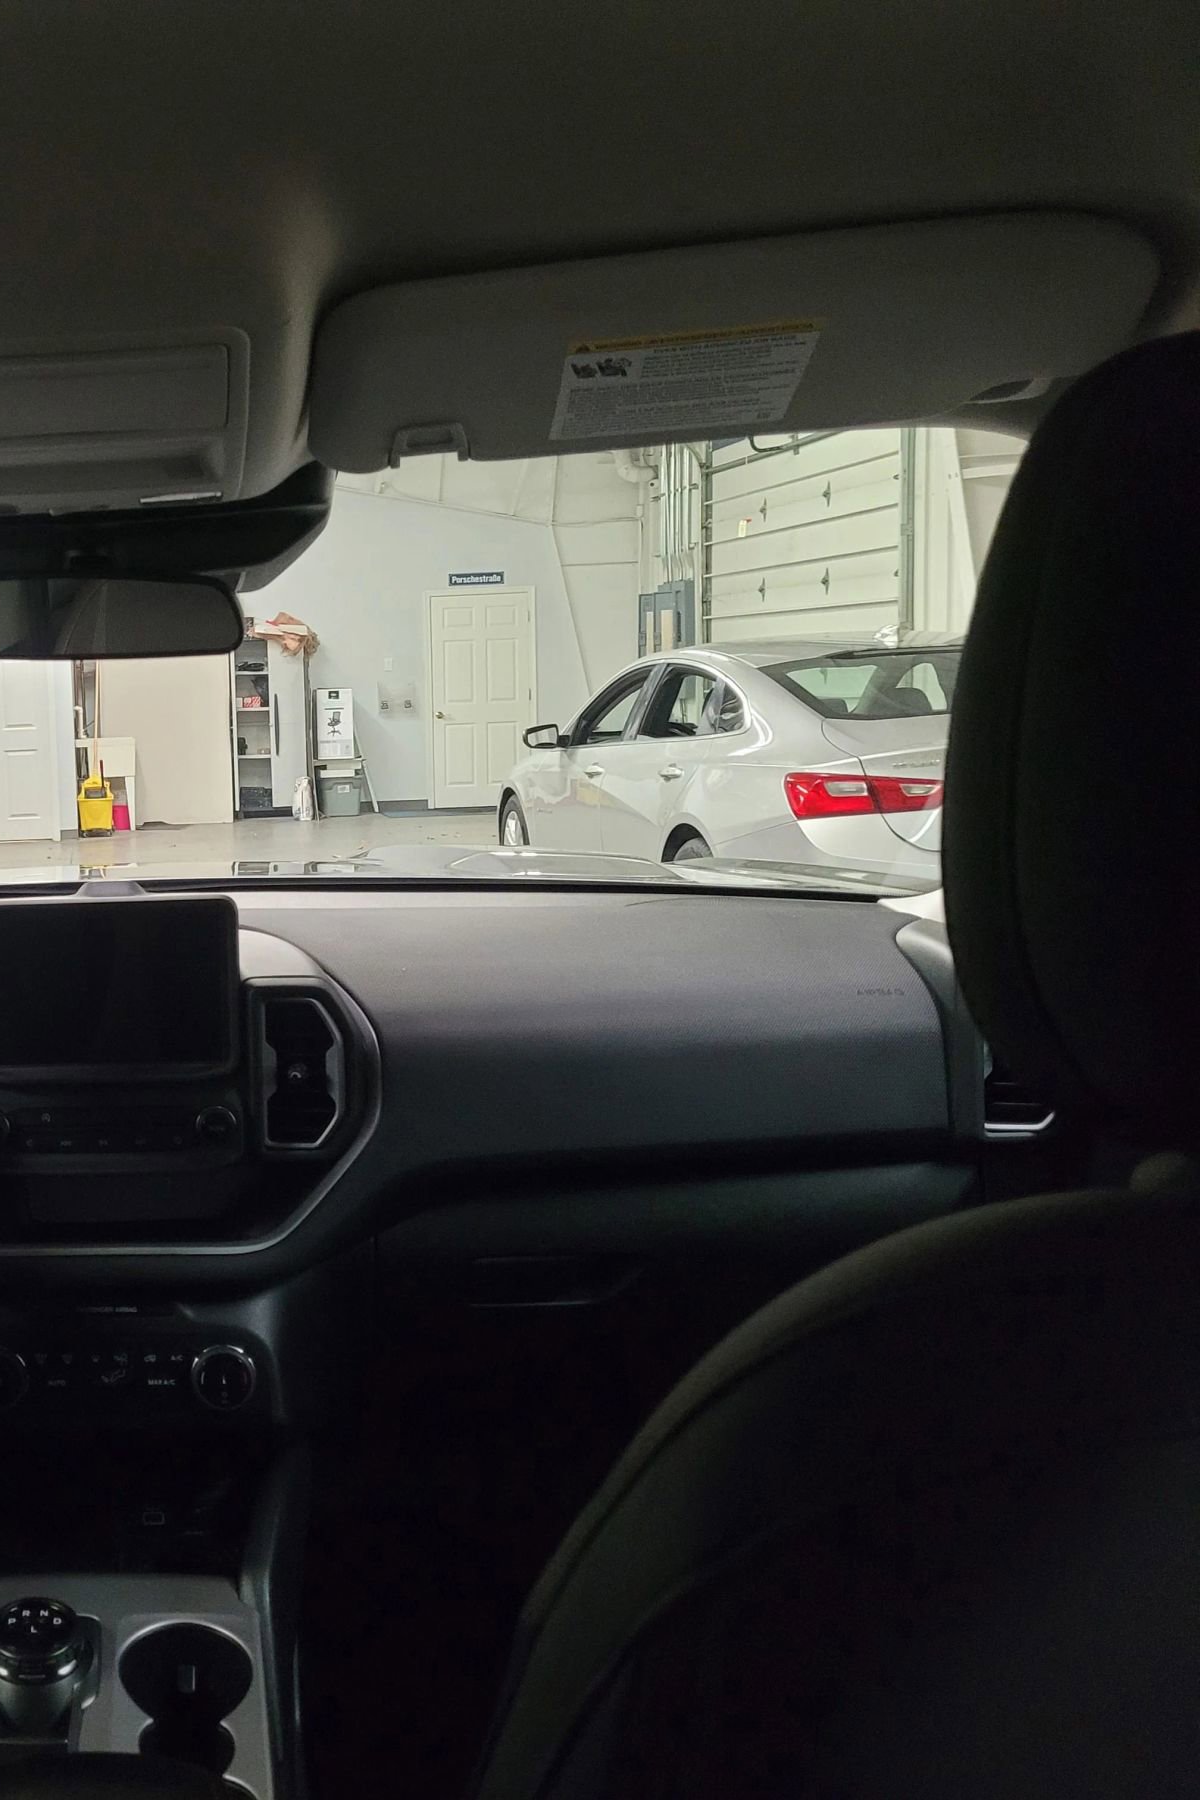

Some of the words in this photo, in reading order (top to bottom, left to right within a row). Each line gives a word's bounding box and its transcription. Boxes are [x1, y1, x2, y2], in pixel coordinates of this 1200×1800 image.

[451, 574, 502, 584] Porschestraße
[8, 1617, 17, 1625] P
[22, 1609, 31, 1617] R
[40, 1609, 49, 1617] N
[53, 1617, 62, 1625] D
[30, 1625, 38, 1634] L
